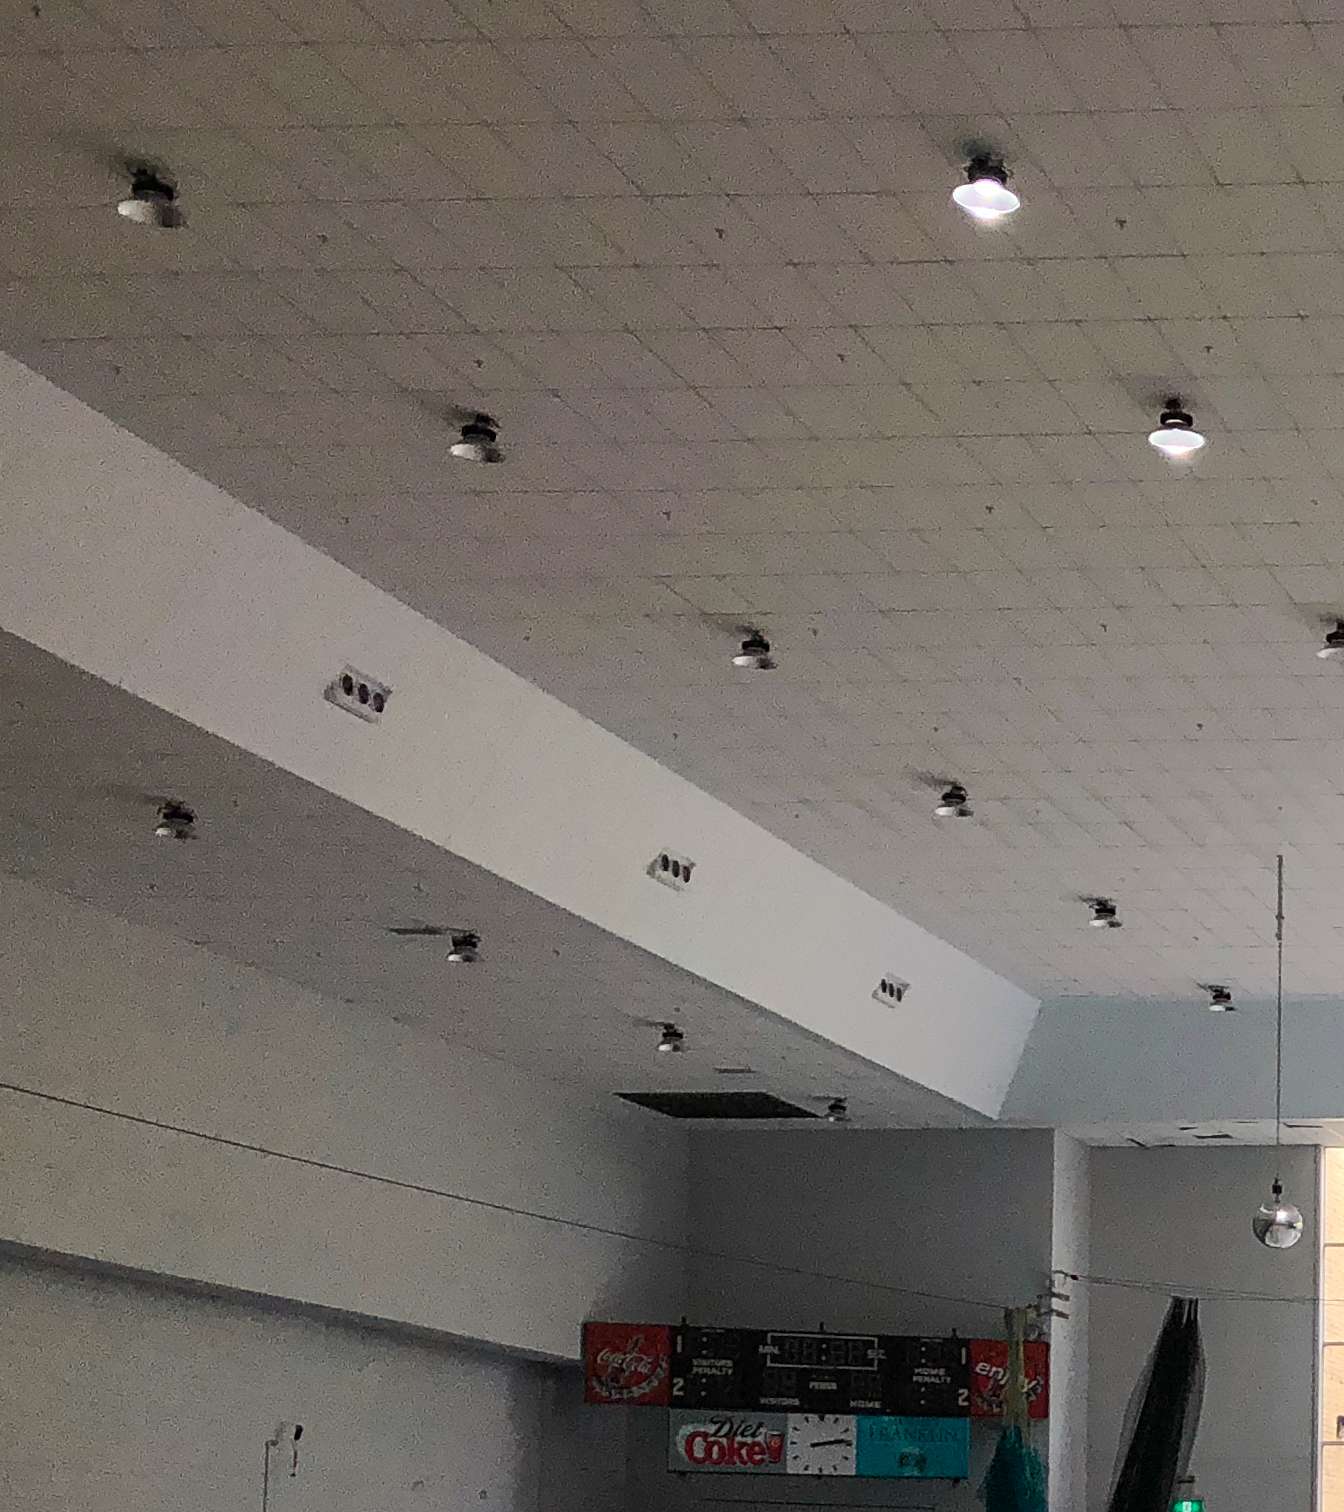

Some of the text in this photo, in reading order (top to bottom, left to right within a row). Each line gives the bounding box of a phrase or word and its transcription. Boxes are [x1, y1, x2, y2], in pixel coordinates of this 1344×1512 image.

[690, 1366, 733, 1376] PENALTY
[914, 1367, 946, 1376] HOME
[912, 1375, 952, 1385] PENALTY
[672, 1377, 685, 1396] 2
[957, 1388, 969, 1406] 2
[849, 1399, 882, 1409] HOME
[711, 1415, 765, 1438] Diet
